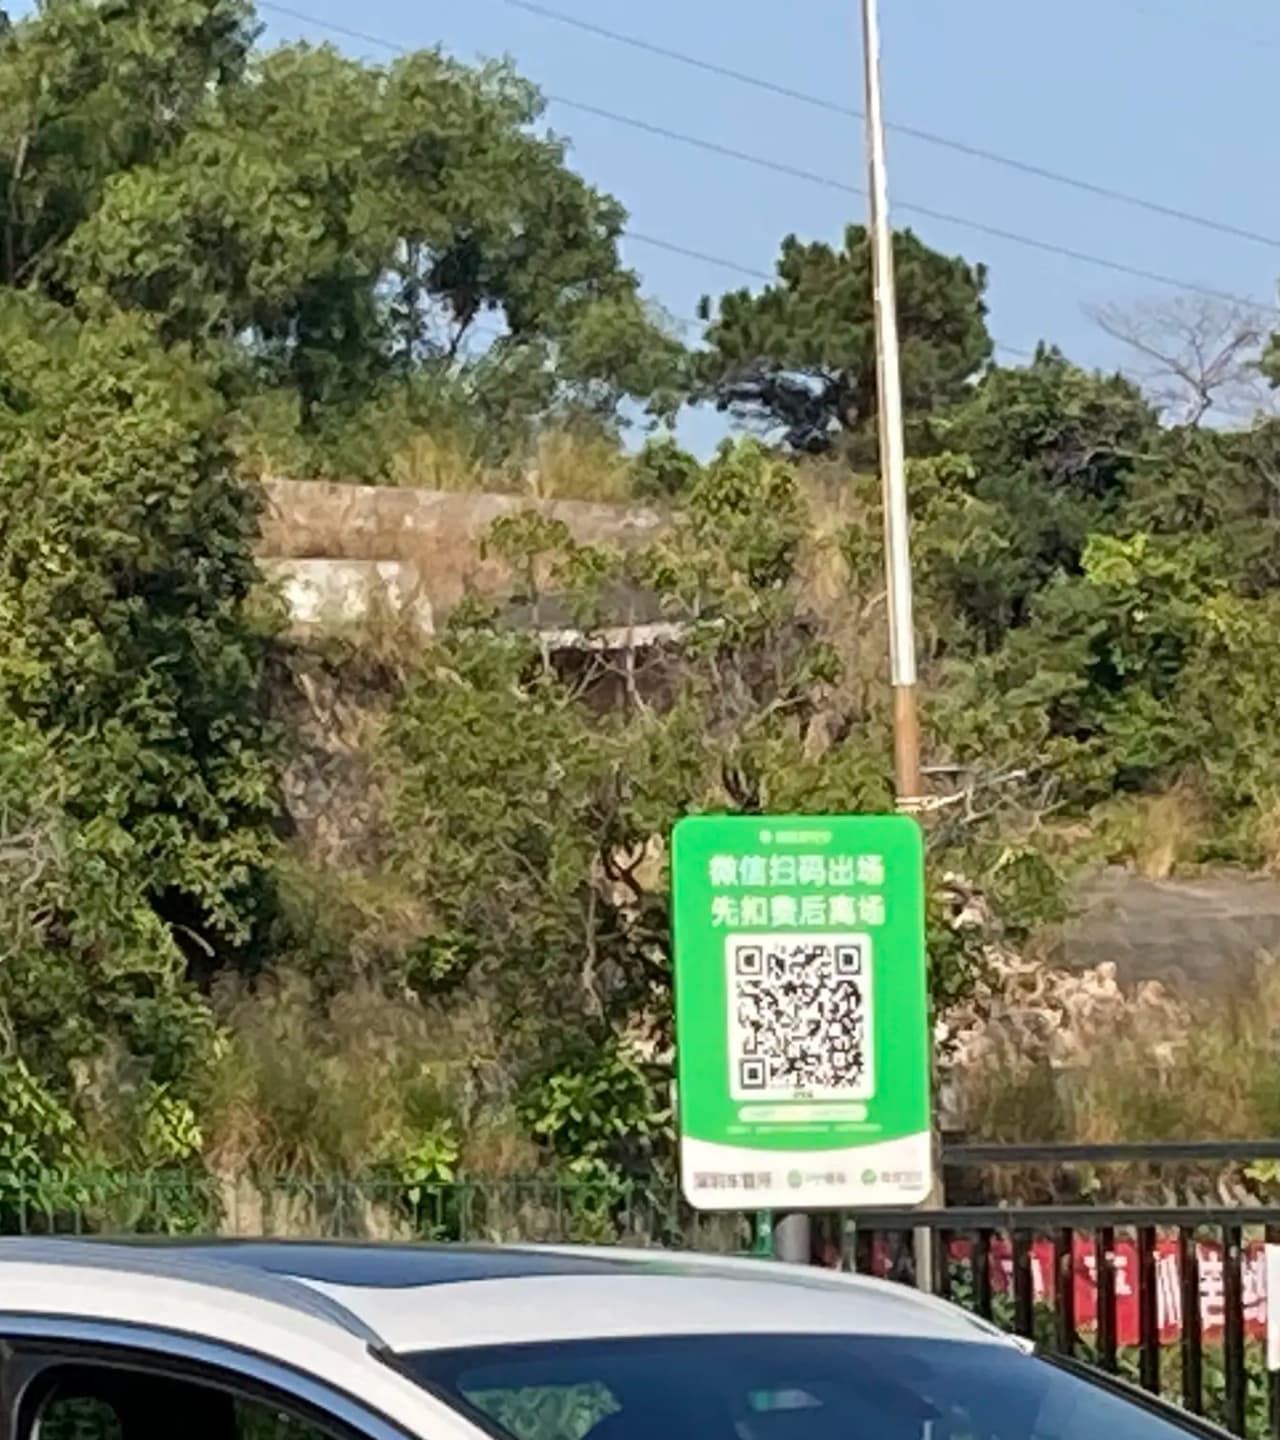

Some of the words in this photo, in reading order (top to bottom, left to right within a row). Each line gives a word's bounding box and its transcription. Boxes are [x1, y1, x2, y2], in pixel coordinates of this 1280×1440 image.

[709, 853, 886, 888] 微信扫码出场
[711, 894, 887, 928] 先扣费后离场
